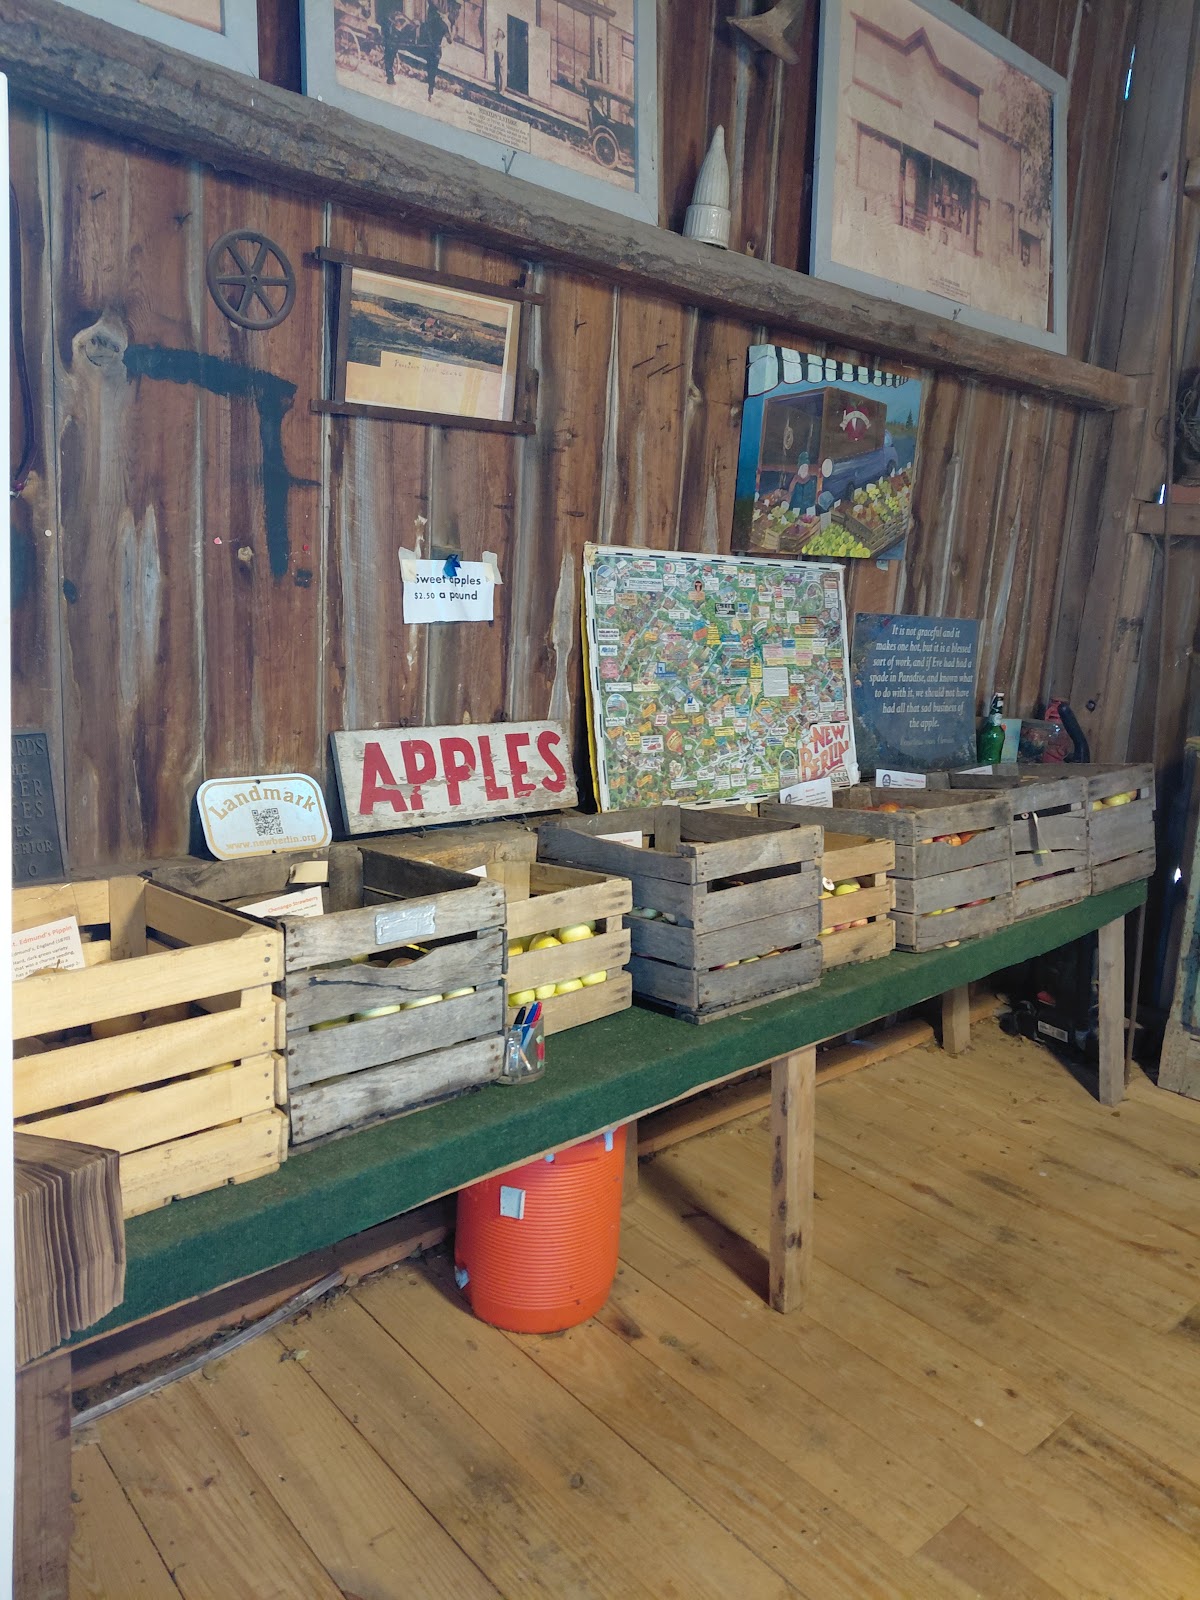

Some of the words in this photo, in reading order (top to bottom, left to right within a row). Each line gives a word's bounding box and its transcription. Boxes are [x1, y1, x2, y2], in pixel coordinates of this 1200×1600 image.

[449, 574, 481, 587] apples
[414, 592, 435, 600] $2.50
[449, 591, 478, 601] pound
[892, 624, 898, 635] It
[899, 625, 905, 635] is
[906, 628, 916, 636] not
[916, 626, 942, 640] graceful
[943, 628, 954, 638] and
[955, 628, 960, 638] it
[876, 640, 896, 651] makes
[897, 643, 909, 651] one
[910, 641, 922, 652] hot,
[922, 642, 933, 652] but
[934, 642, 939, 652] it
[940, 642, 946, 653] is
[951, 643, 972, 653] blessed
[873, 658, 886, 667] sort
[887, 655, 896, 670] of
[896, 656, 912, 669] work,
[913, 657, 925, 667] and
[926, 656, 933, 671] if
[932, 657, 943, 667] Eve
[943, 657, 955, 668] had
[956, 658, 967, 668] had
[869, 671, 888, 686] spade
[889, 671, 896, 682] in
[898, 672, 926, 683] Paradise,
[927, 672, 938, 682] and
[939, 672, 958, 682] known
[959, 673, 973, 683] what
[874, 689, 882, 698] to
[882, 687, 891, 698] do
[892, 687, 906, 697] with
[924, 687, 945, 698] should
[945, 690, 955, 698] not
[956, 687, 969, 698] have
[882, 702, 895, 713] had
[896, 702, 906, 713] all
[906, 702, 920, 712] that
[920, 702, 932, 712] sad
[932, 701, 957, 712] business
[957, 701, 965, 716] of
[909, 717, 920, 728] the
[920, 717, 940, 732] apple.
[810, 724, 846, 754] NEW
[799, 740, 850, 782] BERLIN
[359, 730, 567, 815] APPLES
[208, 785, 316, 821] Landmark
[225, 834, 317, 851] www.newberlin.org
[19, 932, 51, 945] Edmund's
[52, 925, 72, 935] Pippin
[36, 940, 55, 950] England
[38, 951, 52, 959] green
[52, 946, 68, 954] variety
